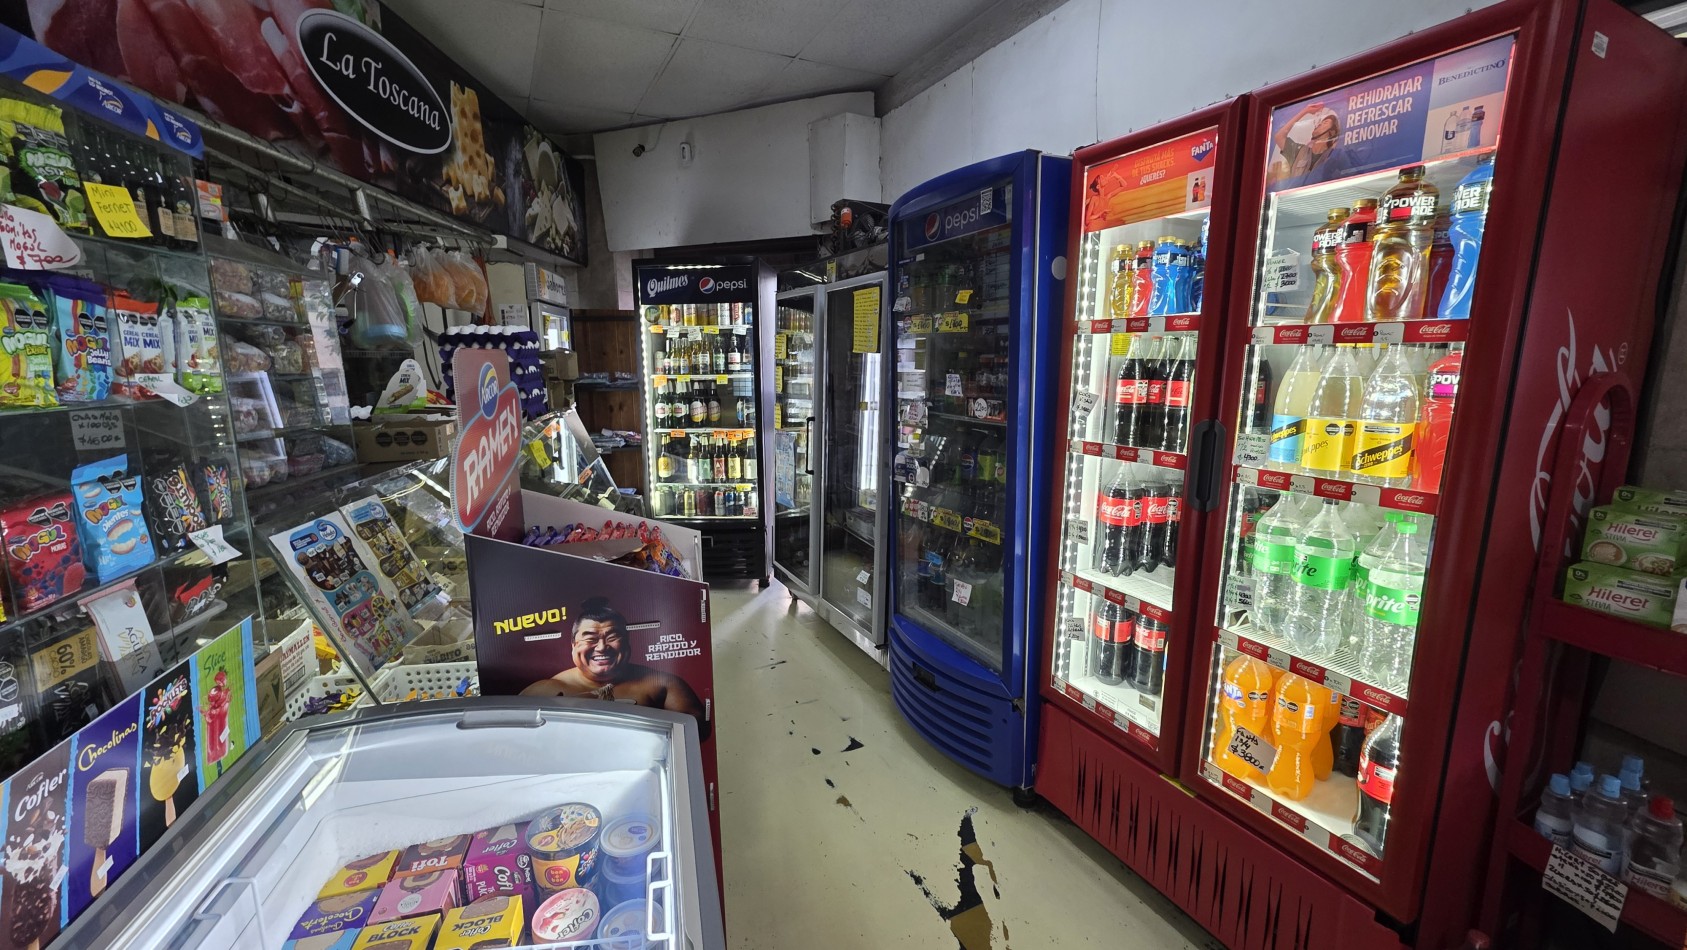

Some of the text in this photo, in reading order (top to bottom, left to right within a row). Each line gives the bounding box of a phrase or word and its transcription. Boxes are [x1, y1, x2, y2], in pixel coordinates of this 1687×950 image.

[319, 32, 441, 131] La Toscana
[1438, 59, 1506, 86] BENEDICTINO
[1348, 75, 1423, 111] REHIDRATAR
[1346, 97, 1413, 129] REFRESCAR
[1343, 119, 1398, 146] RENOVAR
[1191, 140, 1214, 157] FANTA
[91, 186, 115, 199] Mini
[1390, 196, 1435, 209] POWER
[944, 202, 980, 235] pepsi
[1411, 206, 1434, 216] ADE
[647, 274, 689, 298] Quilmes
[716, 278, 747, 291] pepsi
[66, 336, 110, 357] MOGUL
[124, 336, 161, 349] MIX MIX
[481, 380, 498, 406] ARCOR
[463, 398, 519, 516] RAMEN
[1355, 443, 1403, 467] Schweppes
[85, 495, 128, 525] MOGUL
[102, 508, 129, 533] Dientes
[1606, 521, 1659, 539] Hileret
[9, 525, 68, 561] MOGUL
[1366, 594, 1405, 613] prite
[1587, 586, 1650, 609] Hileret
[493, 606, 567, 635] NUEVO!
[125, 626, 148, 674] AGUILA
[648, 639, 697, 653] RÁPIDO Y
[659, 633, 685, 645] RICO,
[56, 643, 76, 675] 60%
[203, 651, 226, 679] Slice
[645, 648, 701, 661] RENDIDOR
[1223, 682, 1243, 698] ANTA
[77, 721, 138, 772] Chocolinas
[14, 768, 67, 822] Cofler
[410, 855, 448, 873] Tofi
[493, 866, 515, 891] Cofl
[366, 923, 422, 944] BLOCK
[451, 914, 505, 932] BLOCK
[556, 908, 594, 940] Cofler
